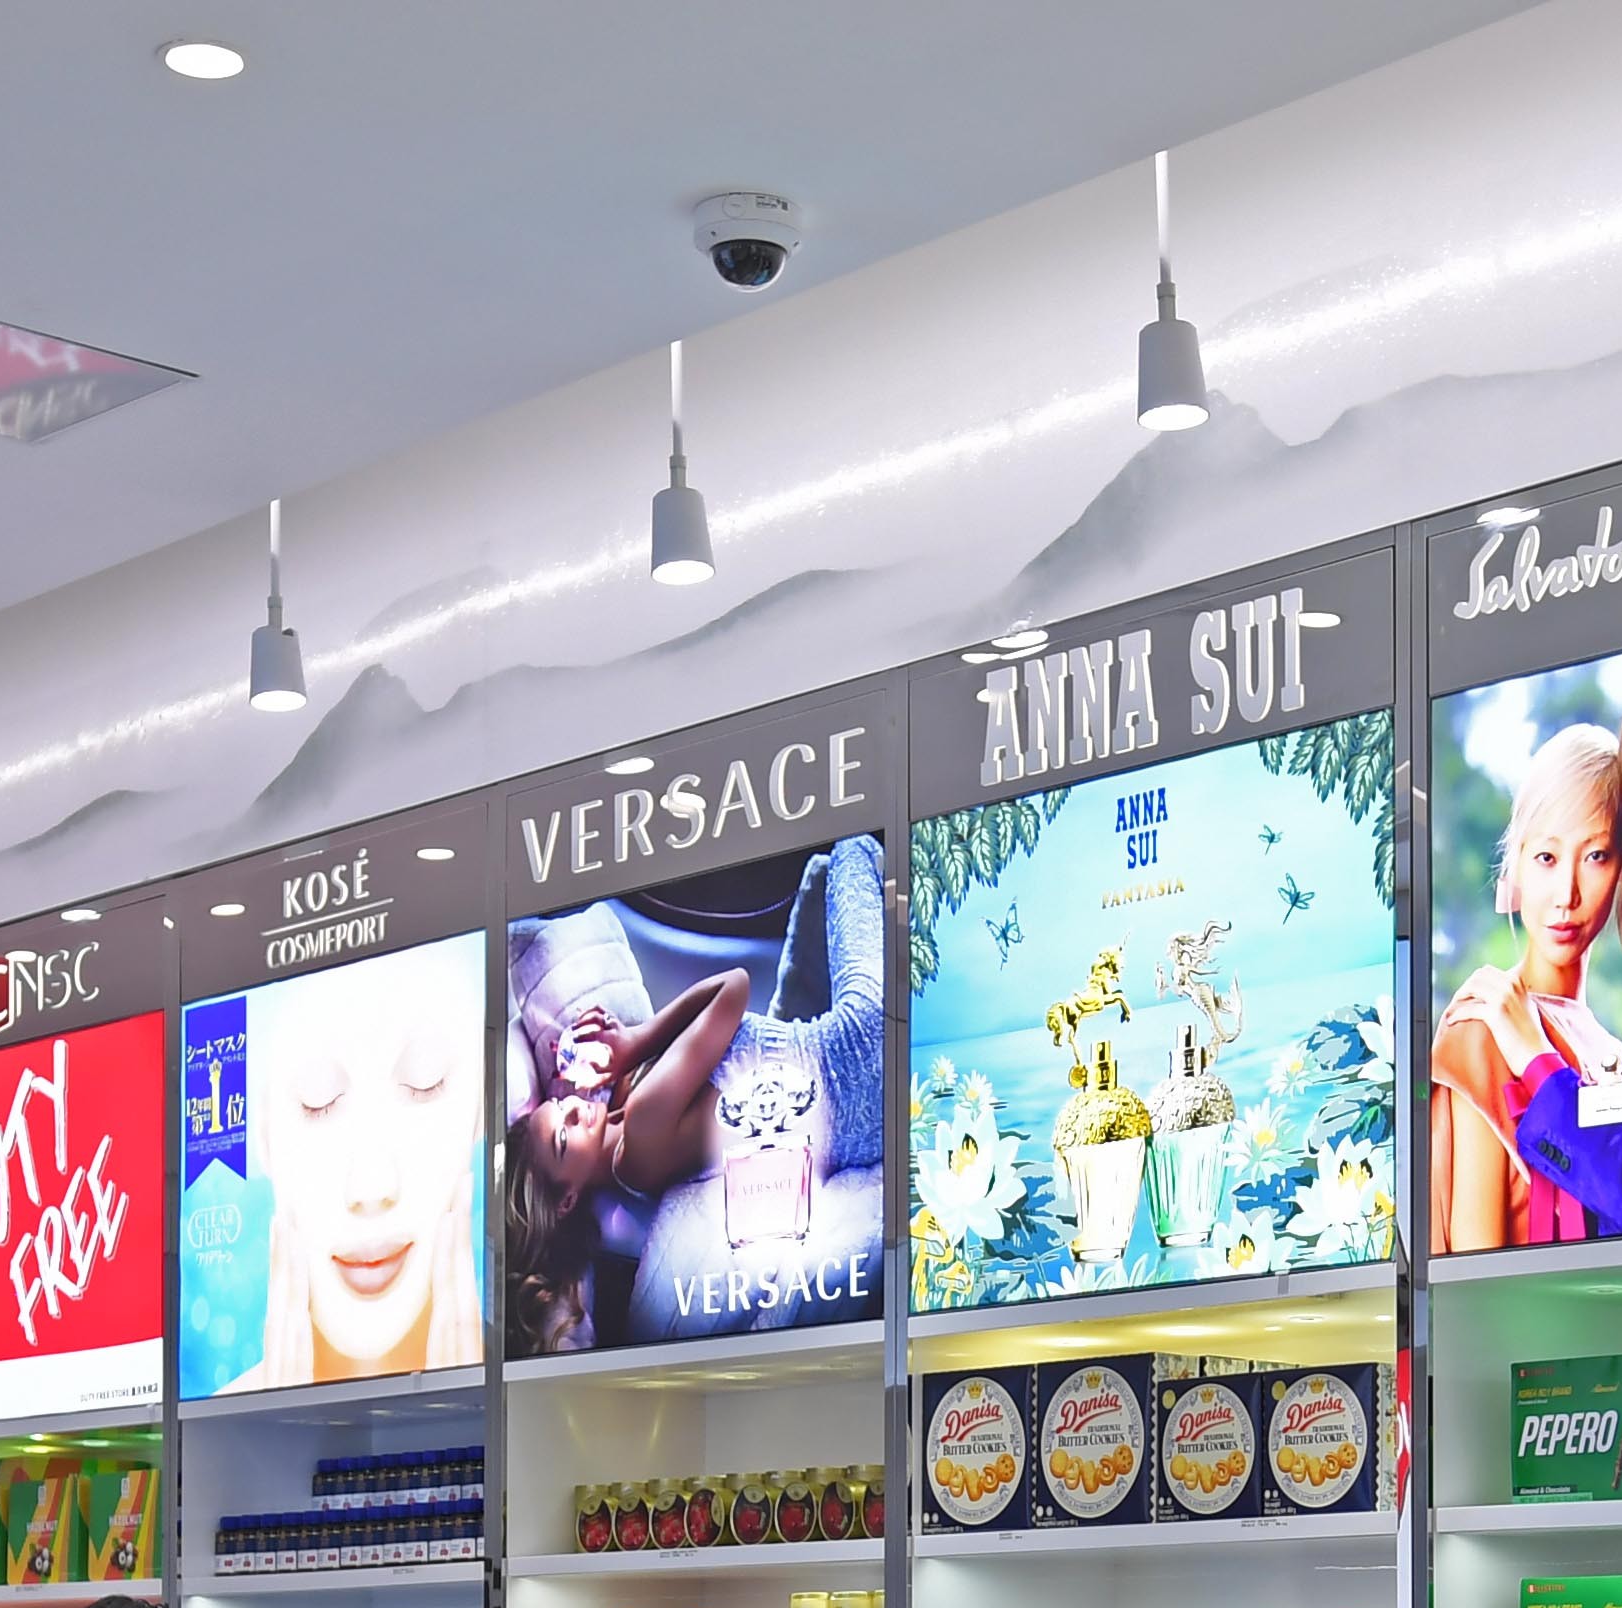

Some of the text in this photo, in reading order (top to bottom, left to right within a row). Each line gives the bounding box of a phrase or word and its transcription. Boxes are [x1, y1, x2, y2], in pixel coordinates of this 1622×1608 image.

[979, 586, 1306, 788] ANNA SUI
[521, 726, 866, 884] VERSACE
[1115, 787, 1168, 833] ANNA
[1127, 829, 1158, 870] SUI
[283, 848, 372, 918] KOSÉ
[1101, 876, 1185, 909] FANTASIA
[267, 911, 390, 969] COSMEPORT
[9, 1134, 129, 1346] FREE
[673, 1252, 870, 1318] VERSACE
[941, 1399, 1004, 1443] Danisa
[1055, 1389, 1122, 1434] Danisa
[1175, 1403, 1235, 1442] Danisa
[1282, 1393, 1346, 1434] Danisa
[1518, 1409, 1618, 1457] PEPERO
[943, 1442, 1007, 1456] BUTTER COOKIES
[1058, 1432, 1126, 1448] BUTTER COOKIES
[1178, 1441, 1239, 1454] BUTTER COOKIES
[1284, 1431, 1349, 1446] BUTTER COOKIES
